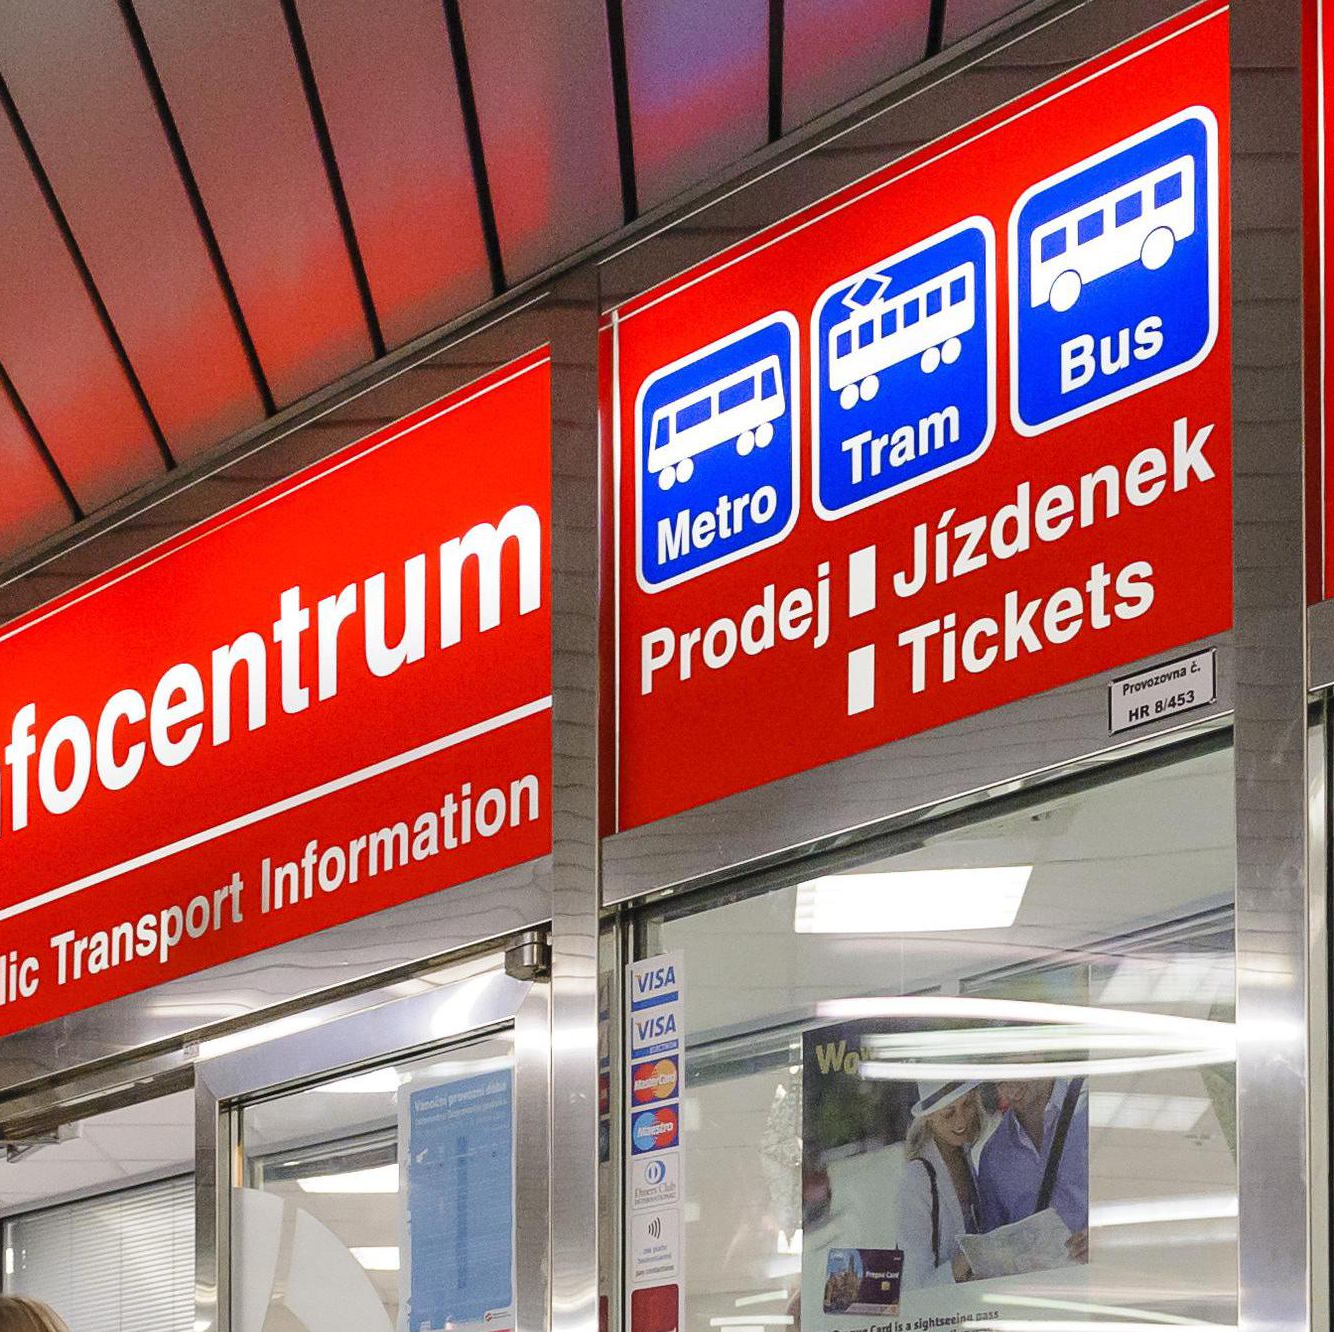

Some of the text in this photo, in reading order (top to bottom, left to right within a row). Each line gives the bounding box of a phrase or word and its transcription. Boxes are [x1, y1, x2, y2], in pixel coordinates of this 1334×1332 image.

[1060, 315, 1164, 394] Bus
[842, 405, 959, 485] Tram
[641, 417, 1216, 696] Prodej Jízdenek
[657, 485, 777, 566] Metro
[899, 558, 1154, 694] Tickets
[1123, 666, 1187, 696] Provozovna
[1129, 690, 1195, 722] HR 8/453
[50, 872, 243, 985] Transport
[261, 774, 539, 914] Information
[635, 966, 676, 993] VISA
[635, 1013, 677, 1040] VISA
[895, 1321, 903, 1332] is
[905, 1322, 912, 1331] a
